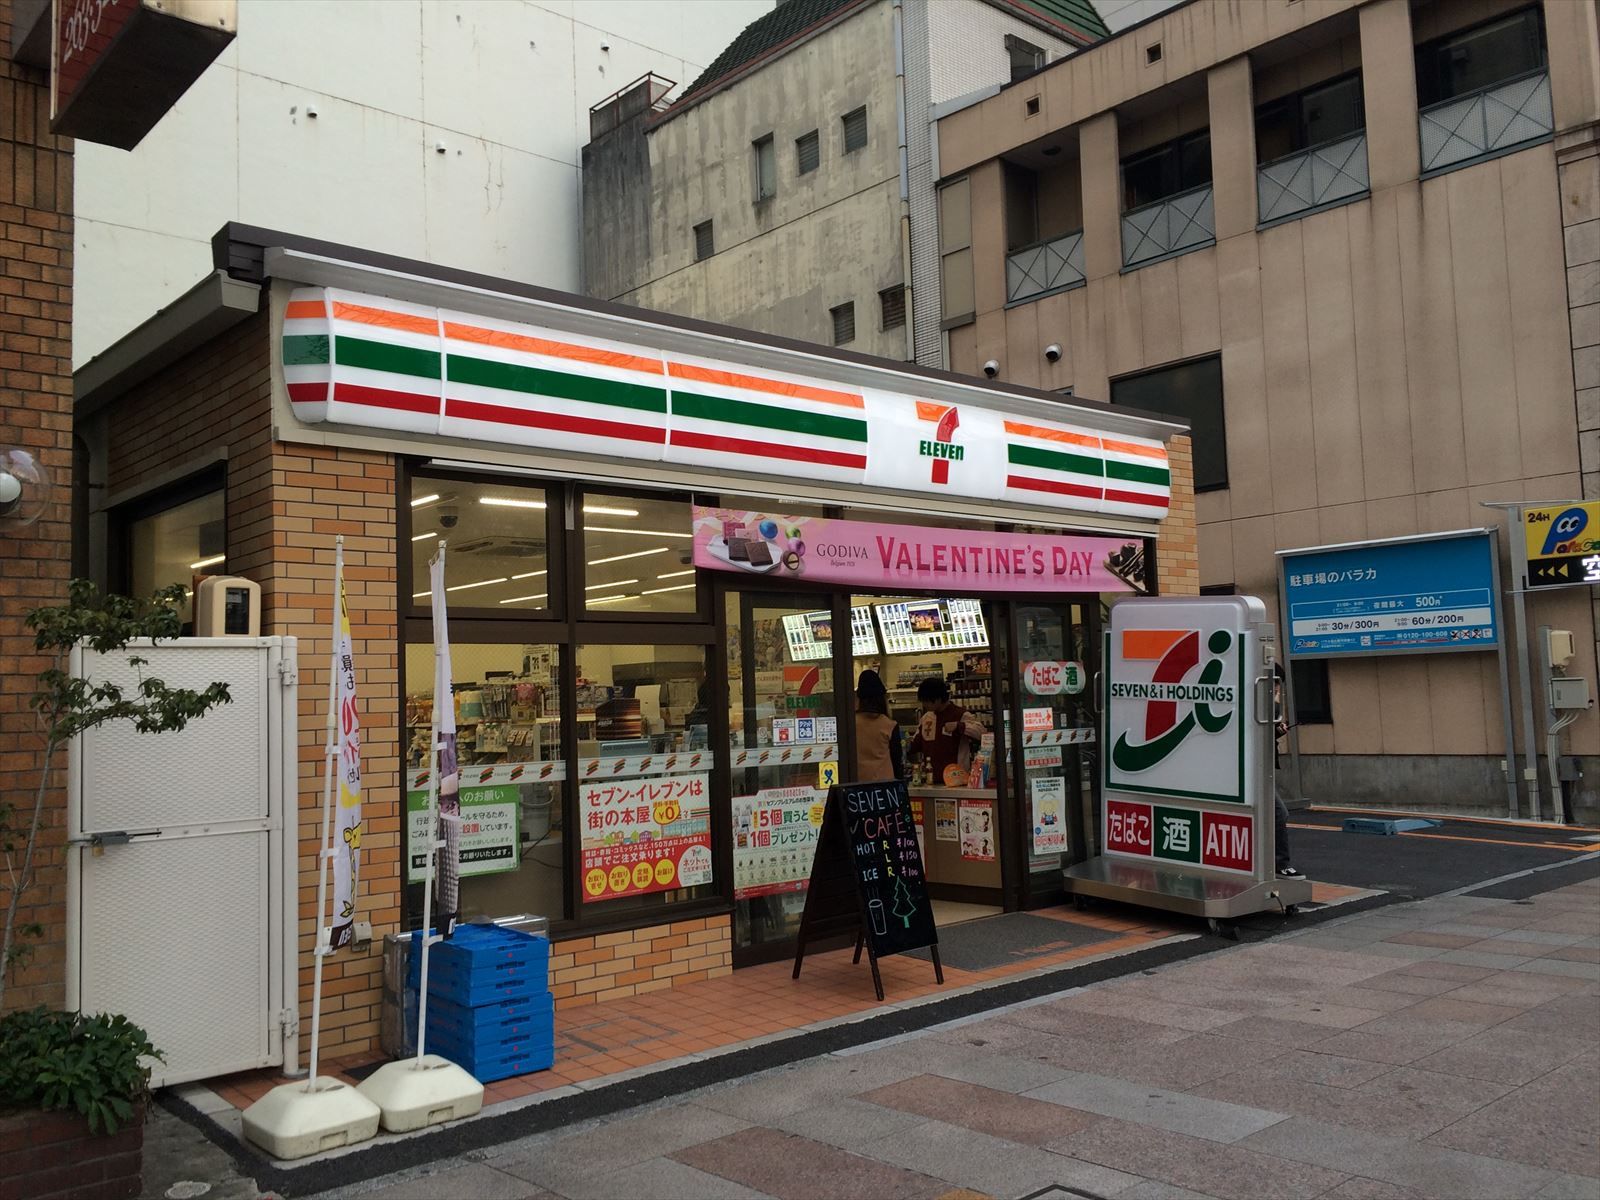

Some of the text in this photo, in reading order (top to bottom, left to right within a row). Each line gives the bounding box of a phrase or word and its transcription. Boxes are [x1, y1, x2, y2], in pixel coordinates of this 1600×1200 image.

[1527, 512, 1550, 523] 24H
[816, 543, 869, 559] GODIVA
[876, 535, 1093, 576] VALENTINE'S DAY
[1031, 665, 1078, 686] たばこ 酒
[1167, 685, 1233, 702] HOLDINGS
[587, 779, 703, 807] セブン-イレブンは
[847, 787, 900, 813] SEVEN
[588, 806, 651, 830] 街の本屋
[760, 808, 809, 827] 5個買うと
[1109, 810, 1249, 861] たばこ 酒 ATM
[856, 841, 876, 856] HOT
[882, 840, 890, 850] R
[885, 853, 892, 863] L
[862, 868, 879, 882] ICE
[887, 866, 895, 878] R
